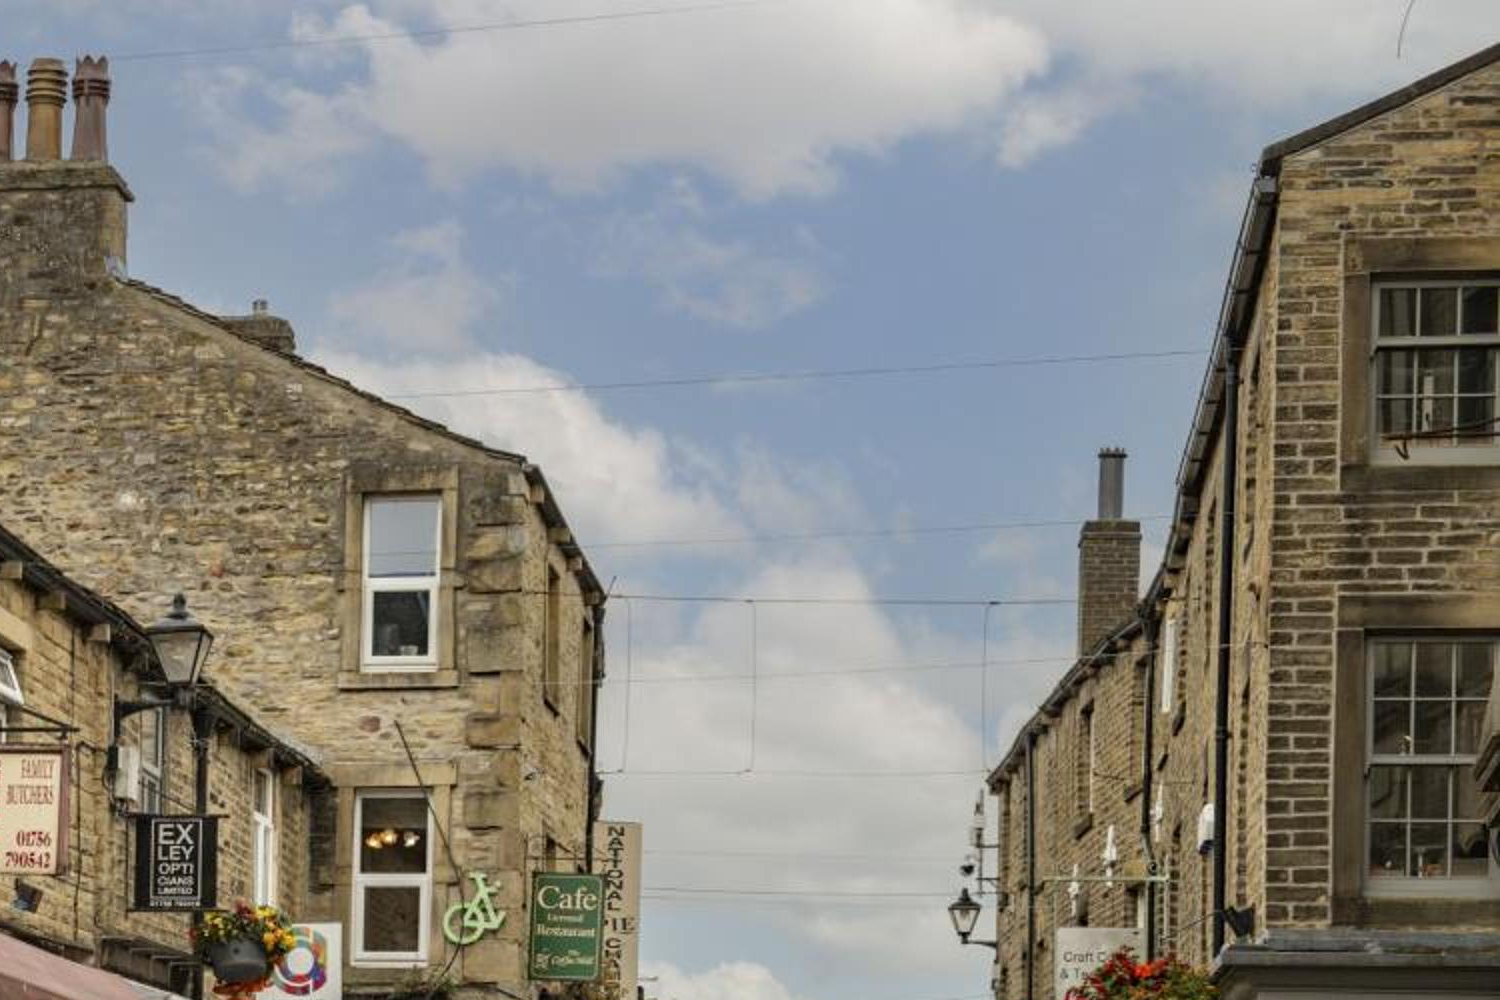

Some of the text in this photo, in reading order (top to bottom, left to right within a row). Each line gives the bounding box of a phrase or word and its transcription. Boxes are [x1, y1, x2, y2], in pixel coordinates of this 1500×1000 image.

[21, 759, 54, 779] FAMILY
[6, 784, 53, 805] BUTCHERS
[16, 831, 51, 847] 01756
[158, 823, 195, 845] EX
[157, 845, 195, 861] LEY
[158, 862, 195, 875] OPTI
[607, 826, 626, 911] NATIONAL
[537, 885, 598, 911] Cafe
[1062, 950, 1094, 963] Craft
